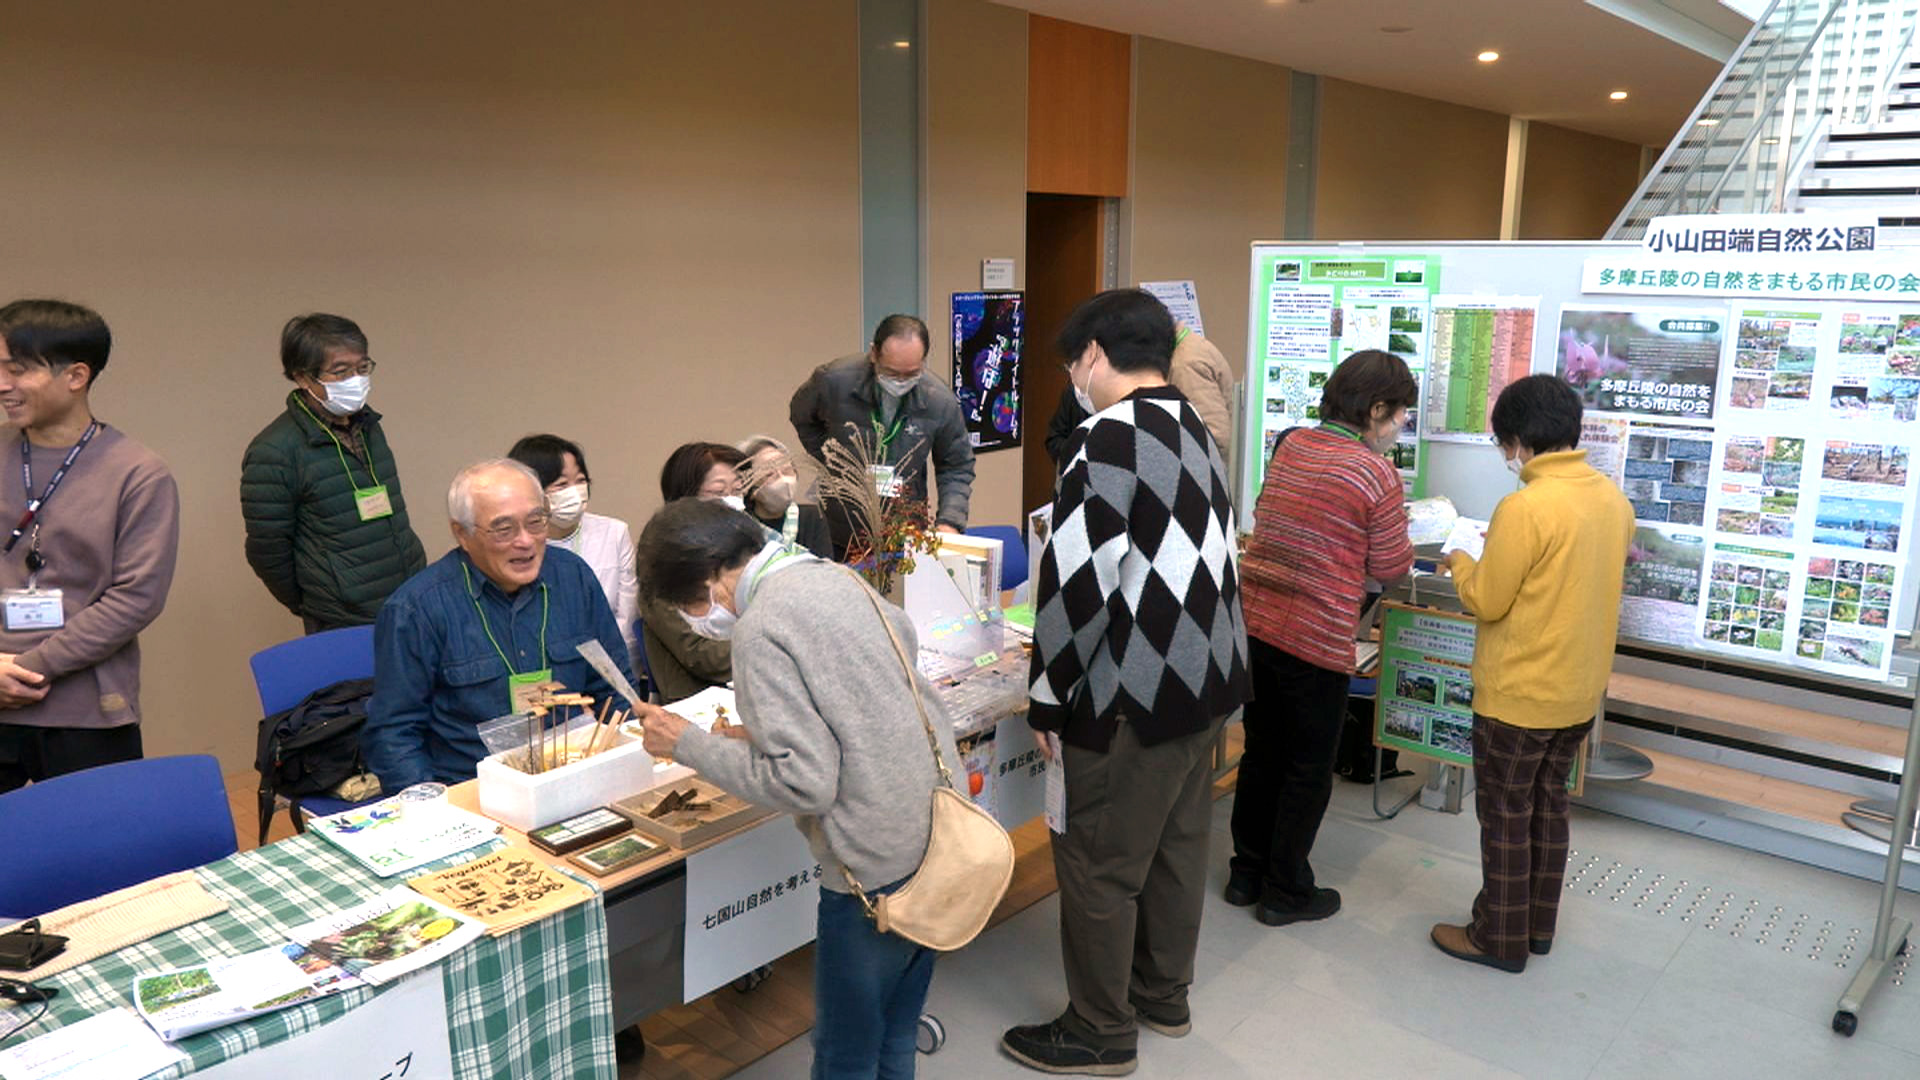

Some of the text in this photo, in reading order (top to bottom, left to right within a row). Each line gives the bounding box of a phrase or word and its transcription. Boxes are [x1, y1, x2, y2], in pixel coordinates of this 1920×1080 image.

[1648, 226, 1876, 253] 小山田端自然公園
[1599, 268, 1920, 292] 多摩丘陵の自然をまもる市民の会
[1600, 378, 1712, 399] 多摩丘陵の自然を
[1613, 395, 1710, 414] まもる市民の会
[702, 863, 823, 930] 七国山自然を考える
